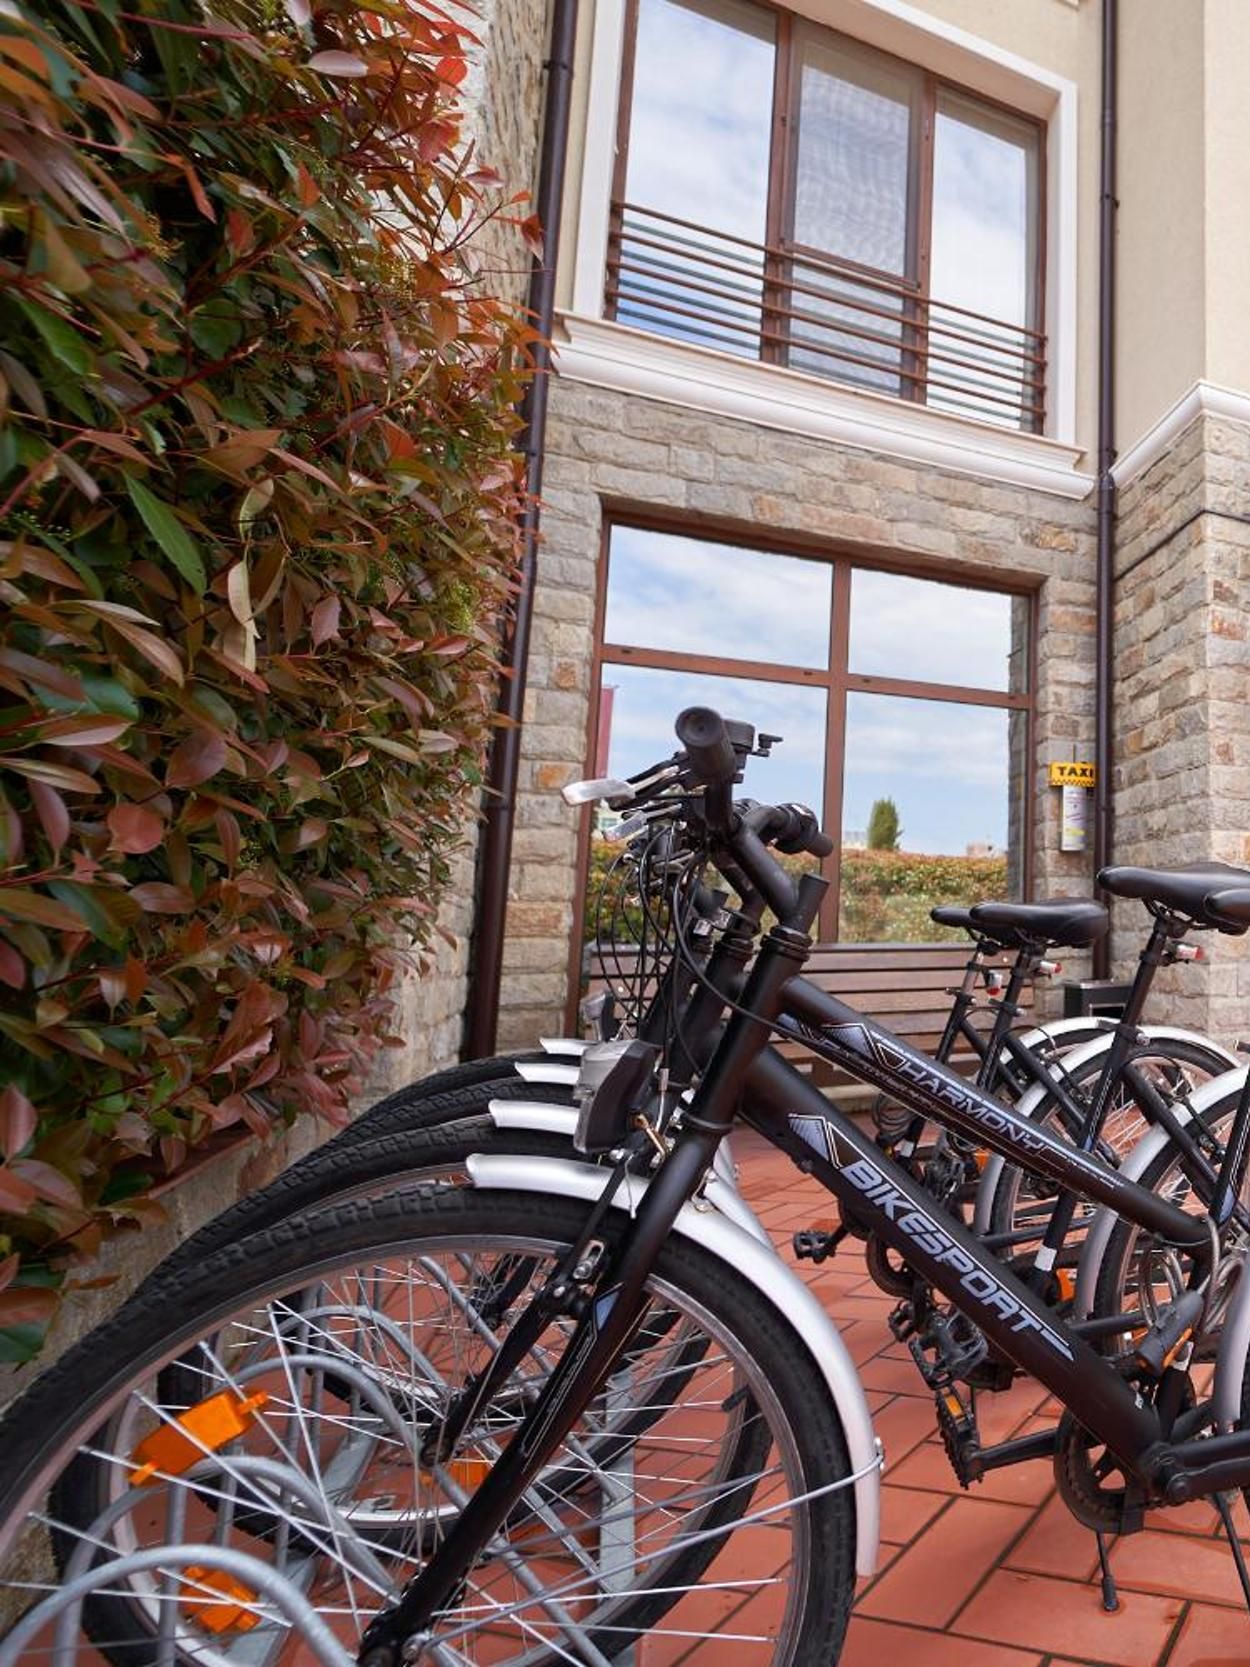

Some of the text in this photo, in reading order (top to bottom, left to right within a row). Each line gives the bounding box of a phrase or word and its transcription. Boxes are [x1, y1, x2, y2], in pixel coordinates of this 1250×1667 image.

[1057, 766, 1093, 778] TAXI
[897, 1061, 1047, 1153] HARMONY
[840, 1162, 1041, 1333] BIKESPORT
